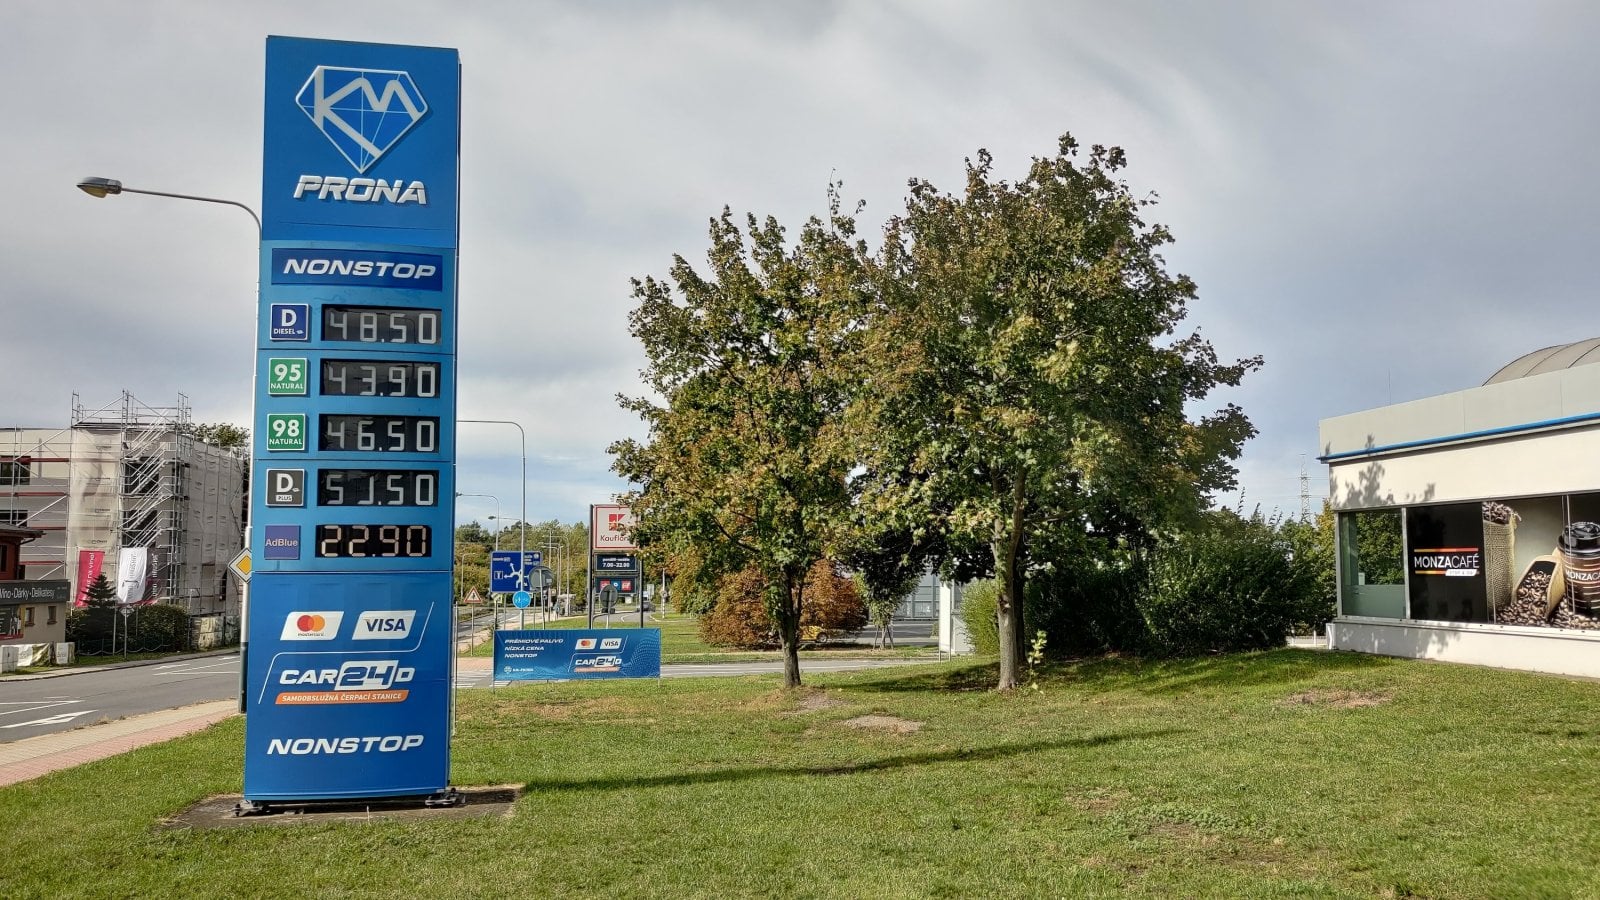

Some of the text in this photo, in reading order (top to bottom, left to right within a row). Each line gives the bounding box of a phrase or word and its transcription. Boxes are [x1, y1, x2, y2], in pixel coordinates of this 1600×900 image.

[293, 174, 427, 205] PRONA
[283, 258, 437, 280] NONSTOP
[281, 308, 297, 327] D
[329, 311, 437, 344] 48.50
[273, 363, 302, 382] 95
[328, 365, 436, 398] 43.90
[272, 419, 300, 437] 98
[327, 420, 435, 452] 46.50
[276, 472, 294, 493] D
[265, 538, 299, 547] AdBlue
[321, 525, 427, 557] 22.90
[1413, 552, 1480, 569] MONZACAFÉ
[363, 618, 406, 632] VISA
[279, 664, 416, 687] CAR24D
[281, 692, 403, 702] SAMOOBSLUŽNÁ ČERPACÍ STANICE
[266, 734, 425, 755] NONSTOP
